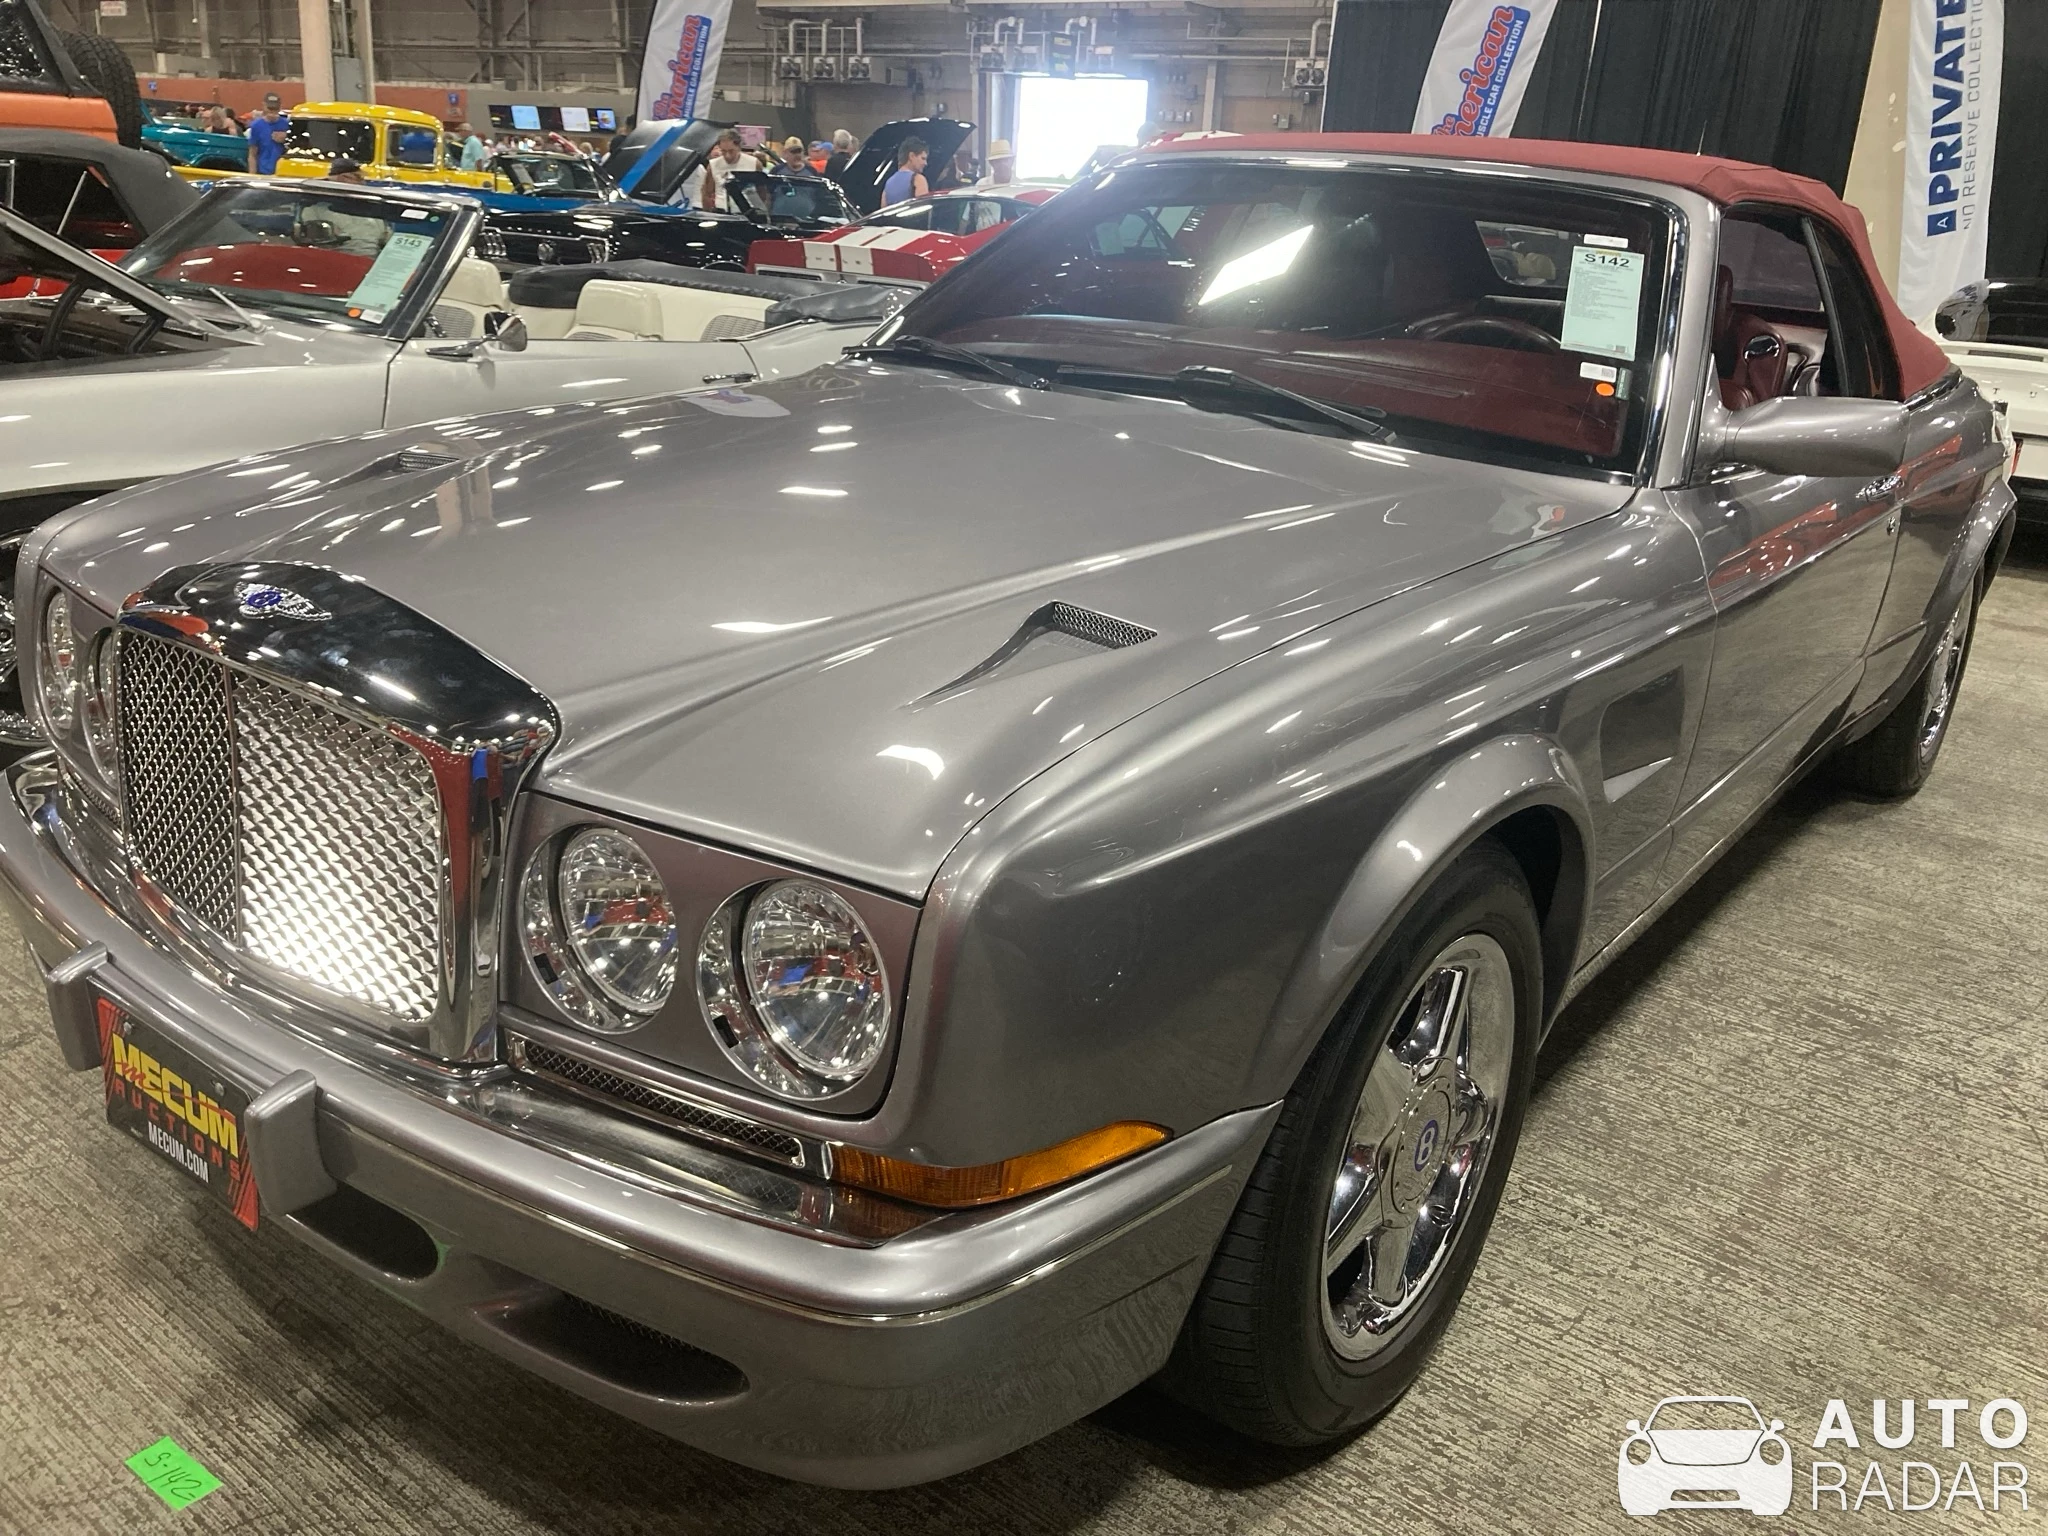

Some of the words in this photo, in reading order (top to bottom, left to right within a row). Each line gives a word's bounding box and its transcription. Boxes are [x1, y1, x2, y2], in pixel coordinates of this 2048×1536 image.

[667, 13, 700, 118] merican
[693, 25, 708, 70] COLLECTION
[1476, 107, 1493, 137] USCLE
[1487, 86, 1501, 105] CAR
[1495, 19, 1524, 82] COLLECTION
[1967, 0, 1984, 103] COLLECTIO
[1963, 108, 1981, 200] RESERVE
[395, 237, 422, 248] S143
[1585, 253, 1630, 268] S142
[112, 1033, 238, 1158] MECUM
[113, 1077, 241, 1182] AUCTIONS
[148, 1121, 209, 1183] MECUM.COM
